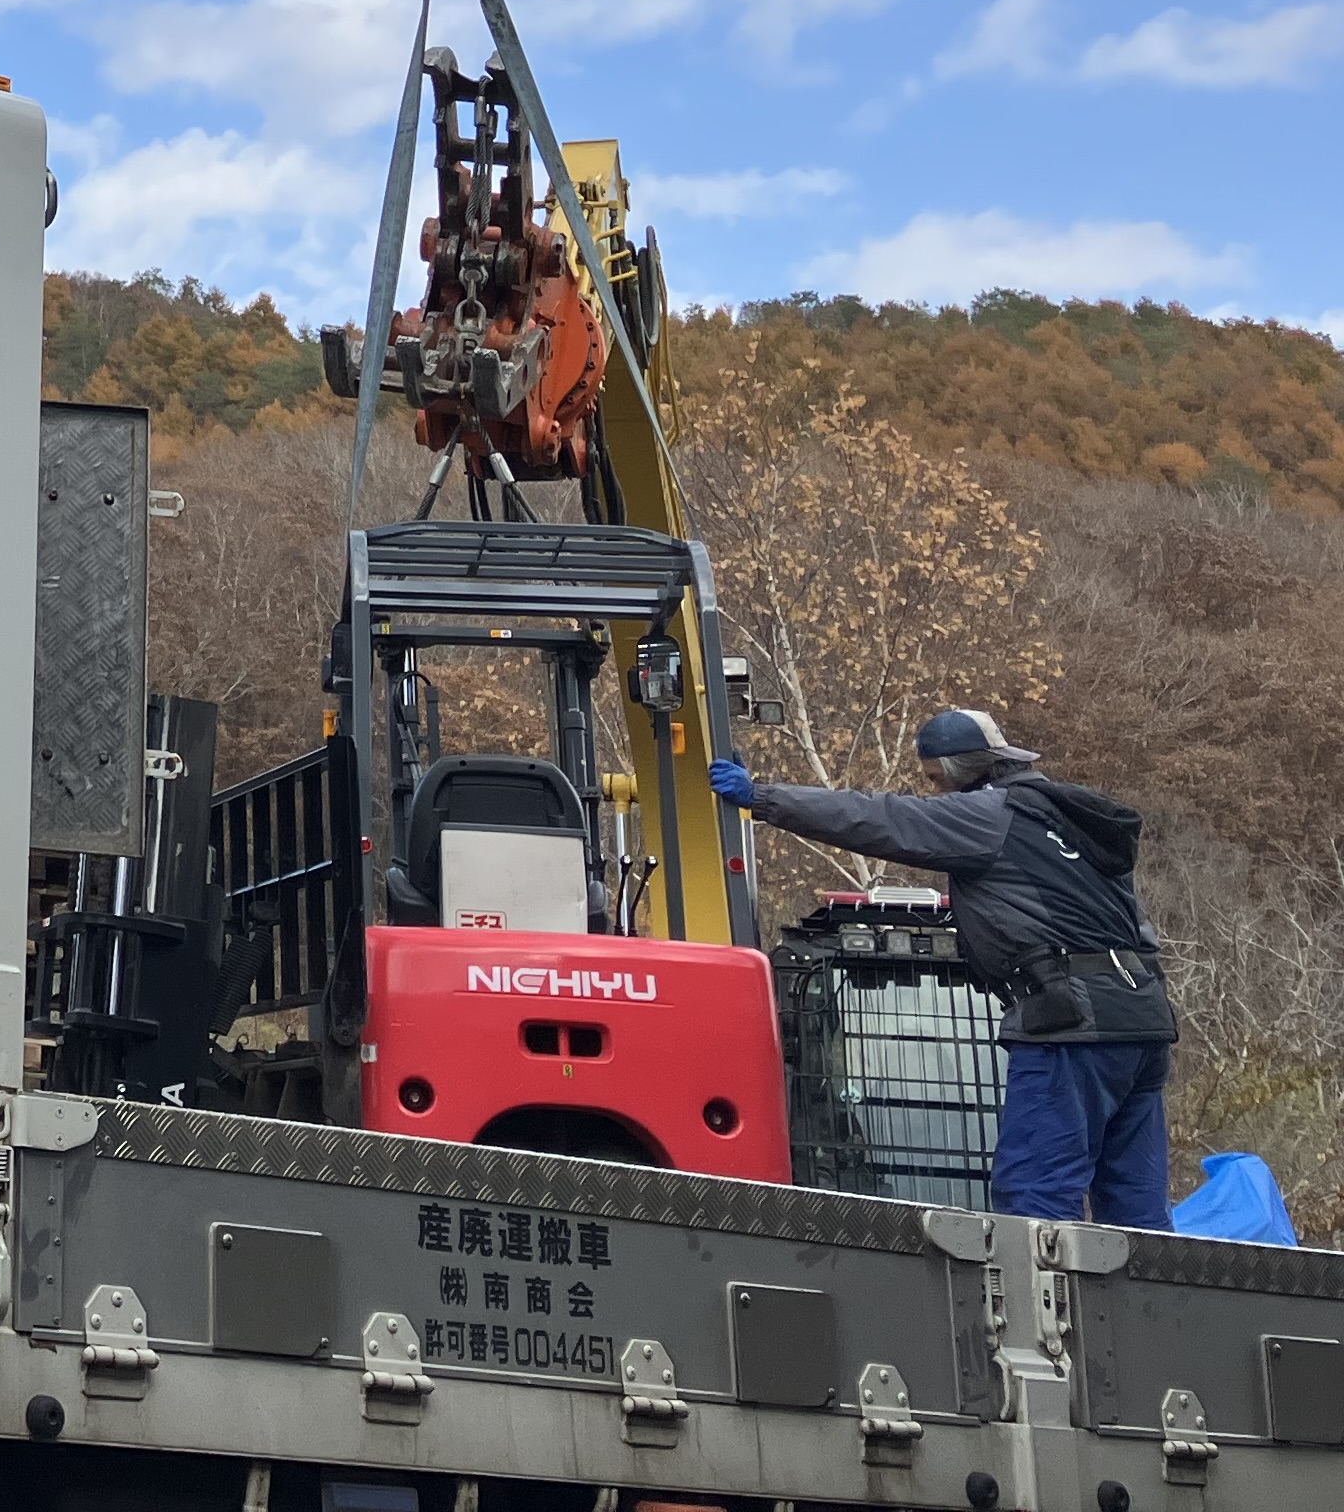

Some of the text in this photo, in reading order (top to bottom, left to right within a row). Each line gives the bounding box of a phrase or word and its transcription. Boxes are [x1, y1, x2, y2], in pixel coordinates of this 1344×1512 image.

[467, 965, 657, 1001] NICHIYU
[417, 1203, 612, 1270] 産廃運搬車
